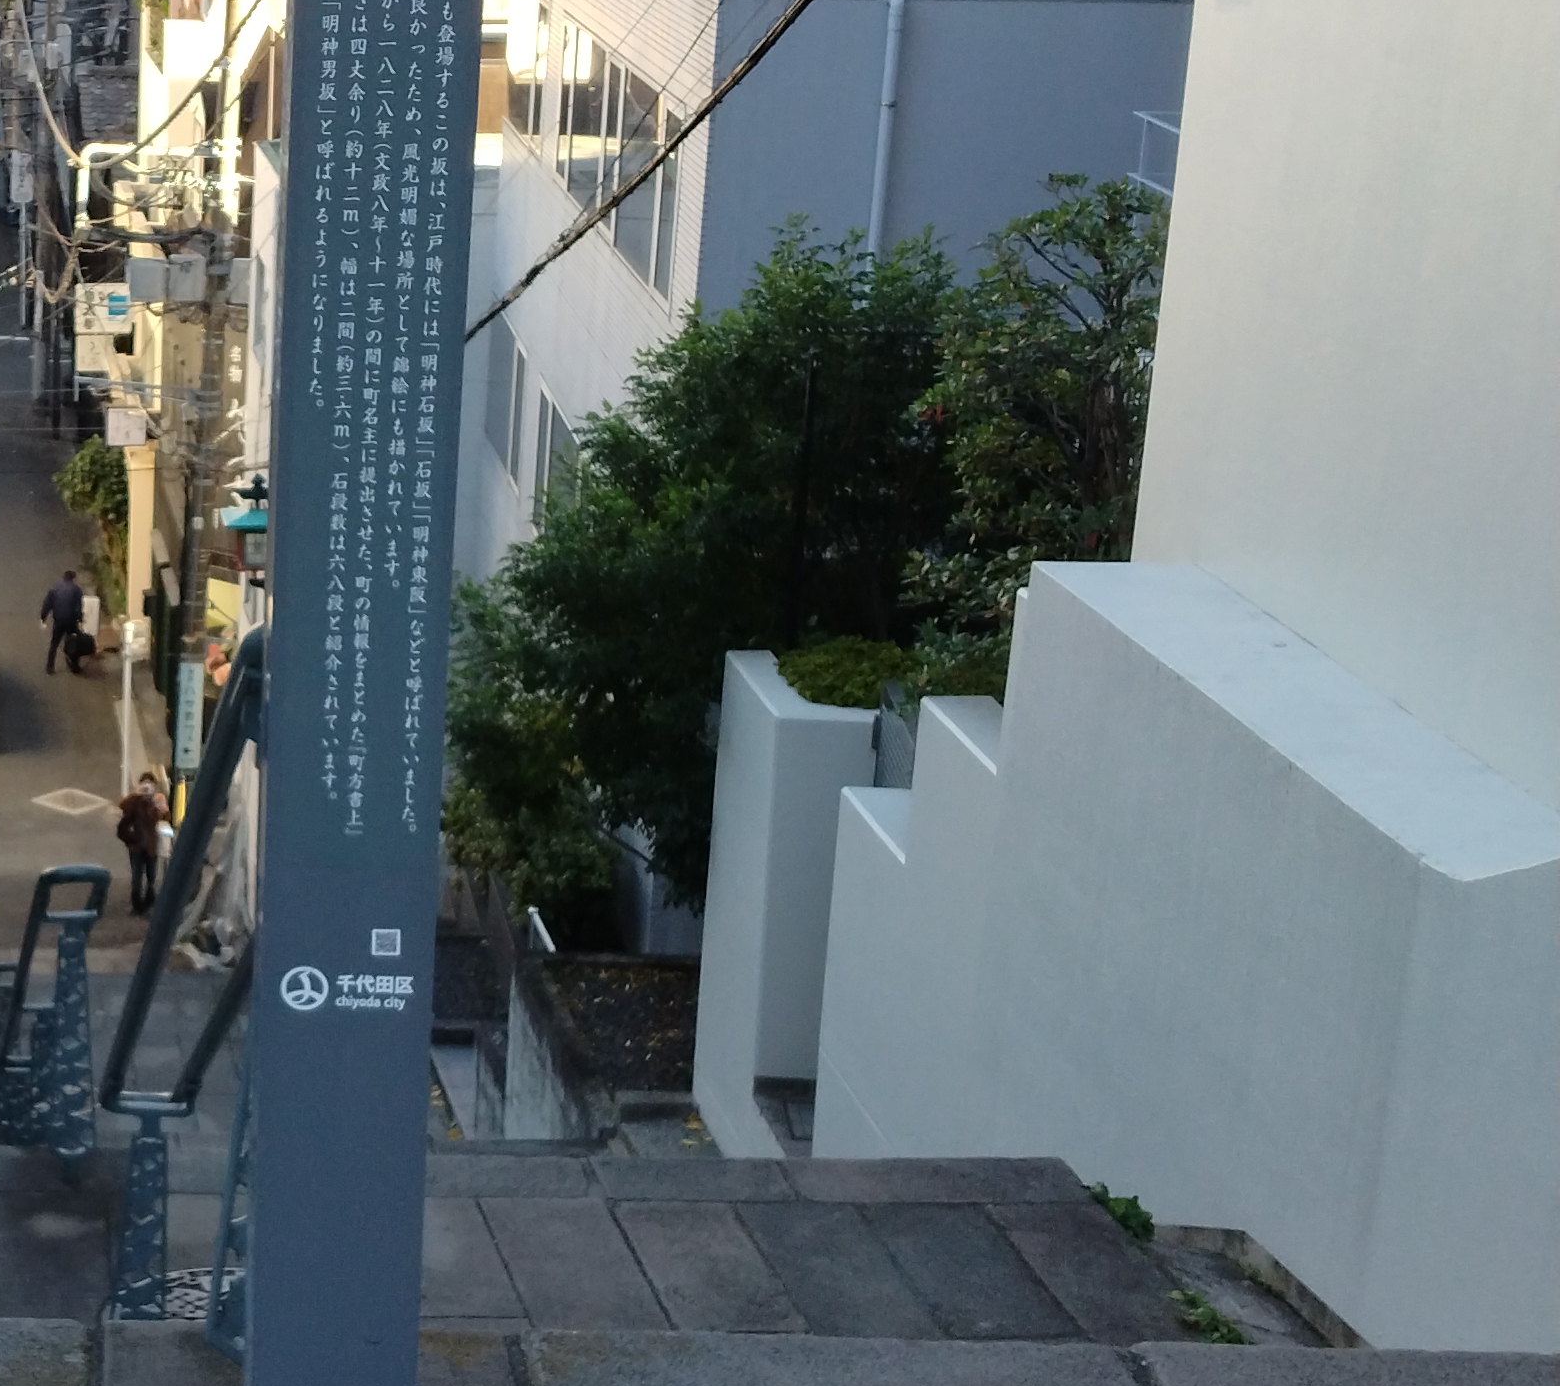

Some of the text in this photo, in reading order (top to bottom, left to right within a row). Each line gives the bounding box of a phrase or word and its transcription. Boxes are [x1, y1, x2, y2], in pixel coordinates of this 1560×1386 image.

[335, 974, 415, 994] 千代田区
[335, 995, 406, 1012] chiyoda city
